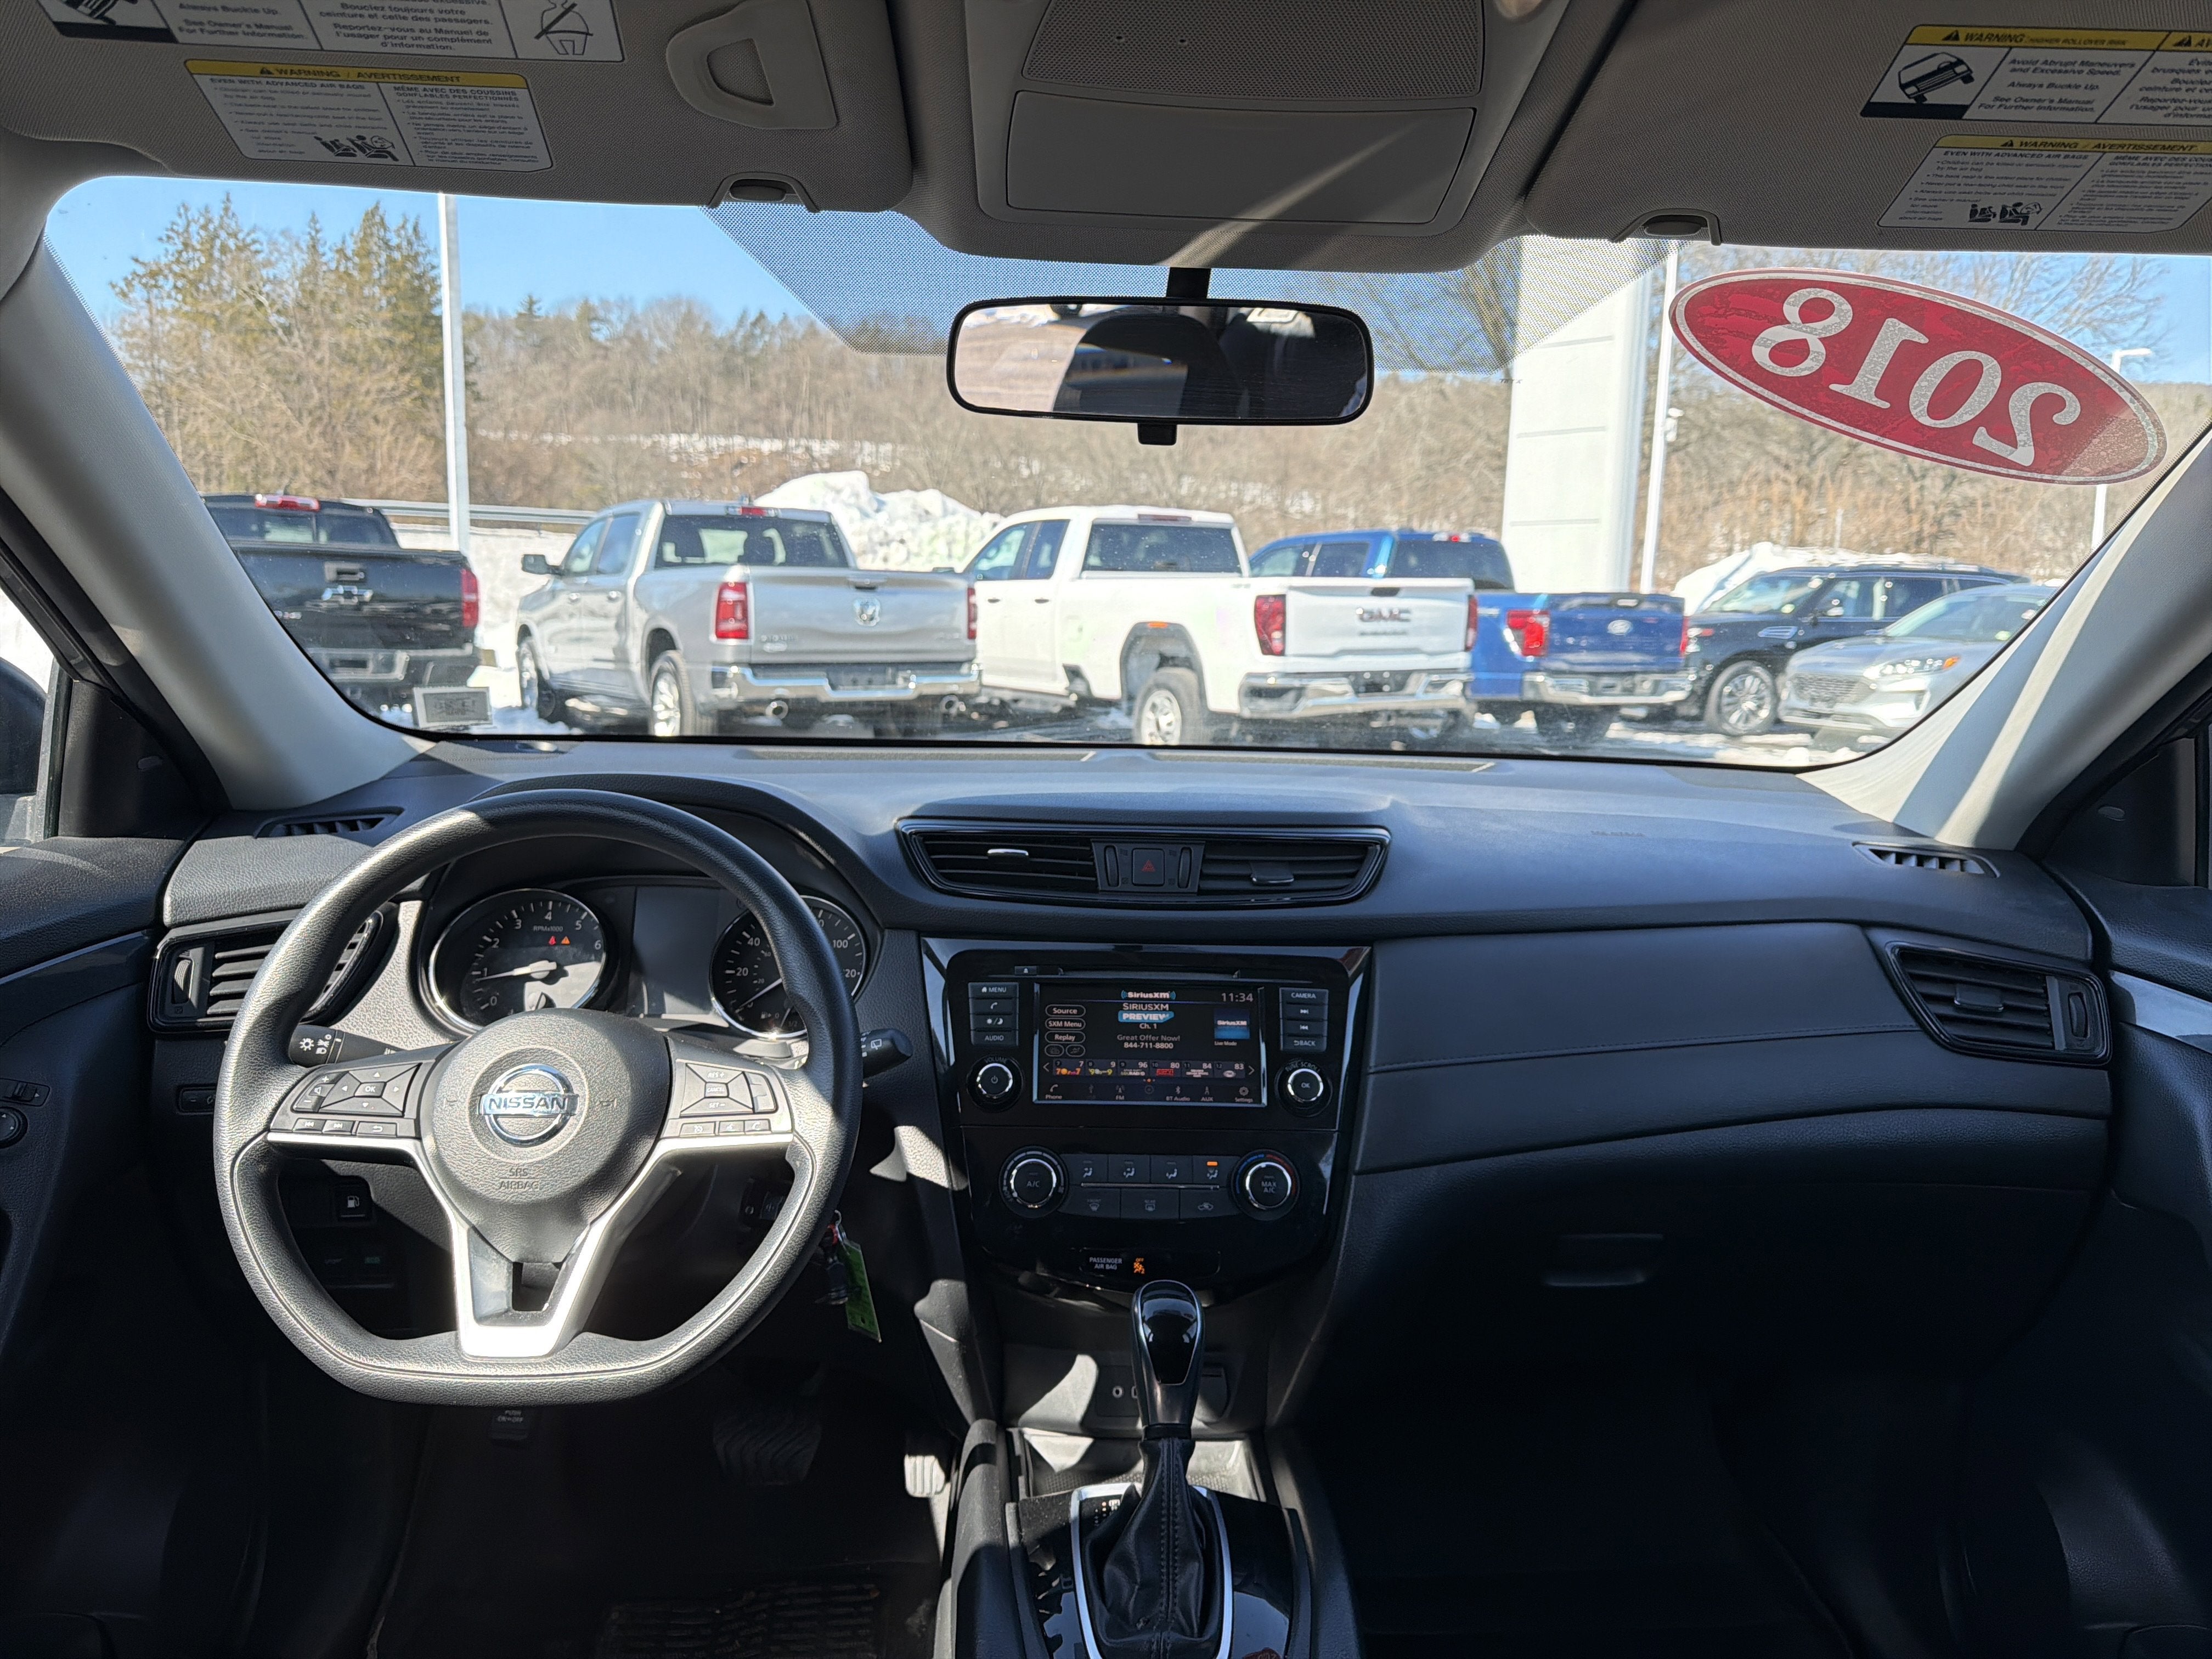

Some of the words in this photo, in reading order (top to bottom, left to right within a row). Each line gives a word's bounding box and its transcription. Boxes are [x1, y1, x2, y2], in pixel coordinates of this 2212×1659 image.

[389, 5, 434, 15] toujours
[1965, 32, 2026, 43] WARNING
[2041, 59, 2078, 67] Abrupt
[275, 68, 340, 77] WARNING
[357, 72, 461, 83] AVERTISSEMENT
[2092, 143, 2198, 151] AVERTISSEMENT
[1359, 608, 1411, 622] GMC
[545, 911, 552, 921] 4
[515, 919, 522, 929] 3
[575, 920, 582, 930] 5
[492, 938, 500, 948] 2
[594, 940, 601, 950] 6
[747, 937, 760, 946] 40
[833, 939, 849, 949] 100
[736, 967, 748, 977] 20
[843, 969, 856, 978] 20
[490, 996, 498, 1006] 0
[1221, 993, 1254, 1002] 11:34
[1054, 1034, 1076, 1042] Replay
[488, 1098, 567, 1110] NISSAN
[509, 1167, 528, 1178] SRS
[499, 1180, 540, 1190] AIRBAG
